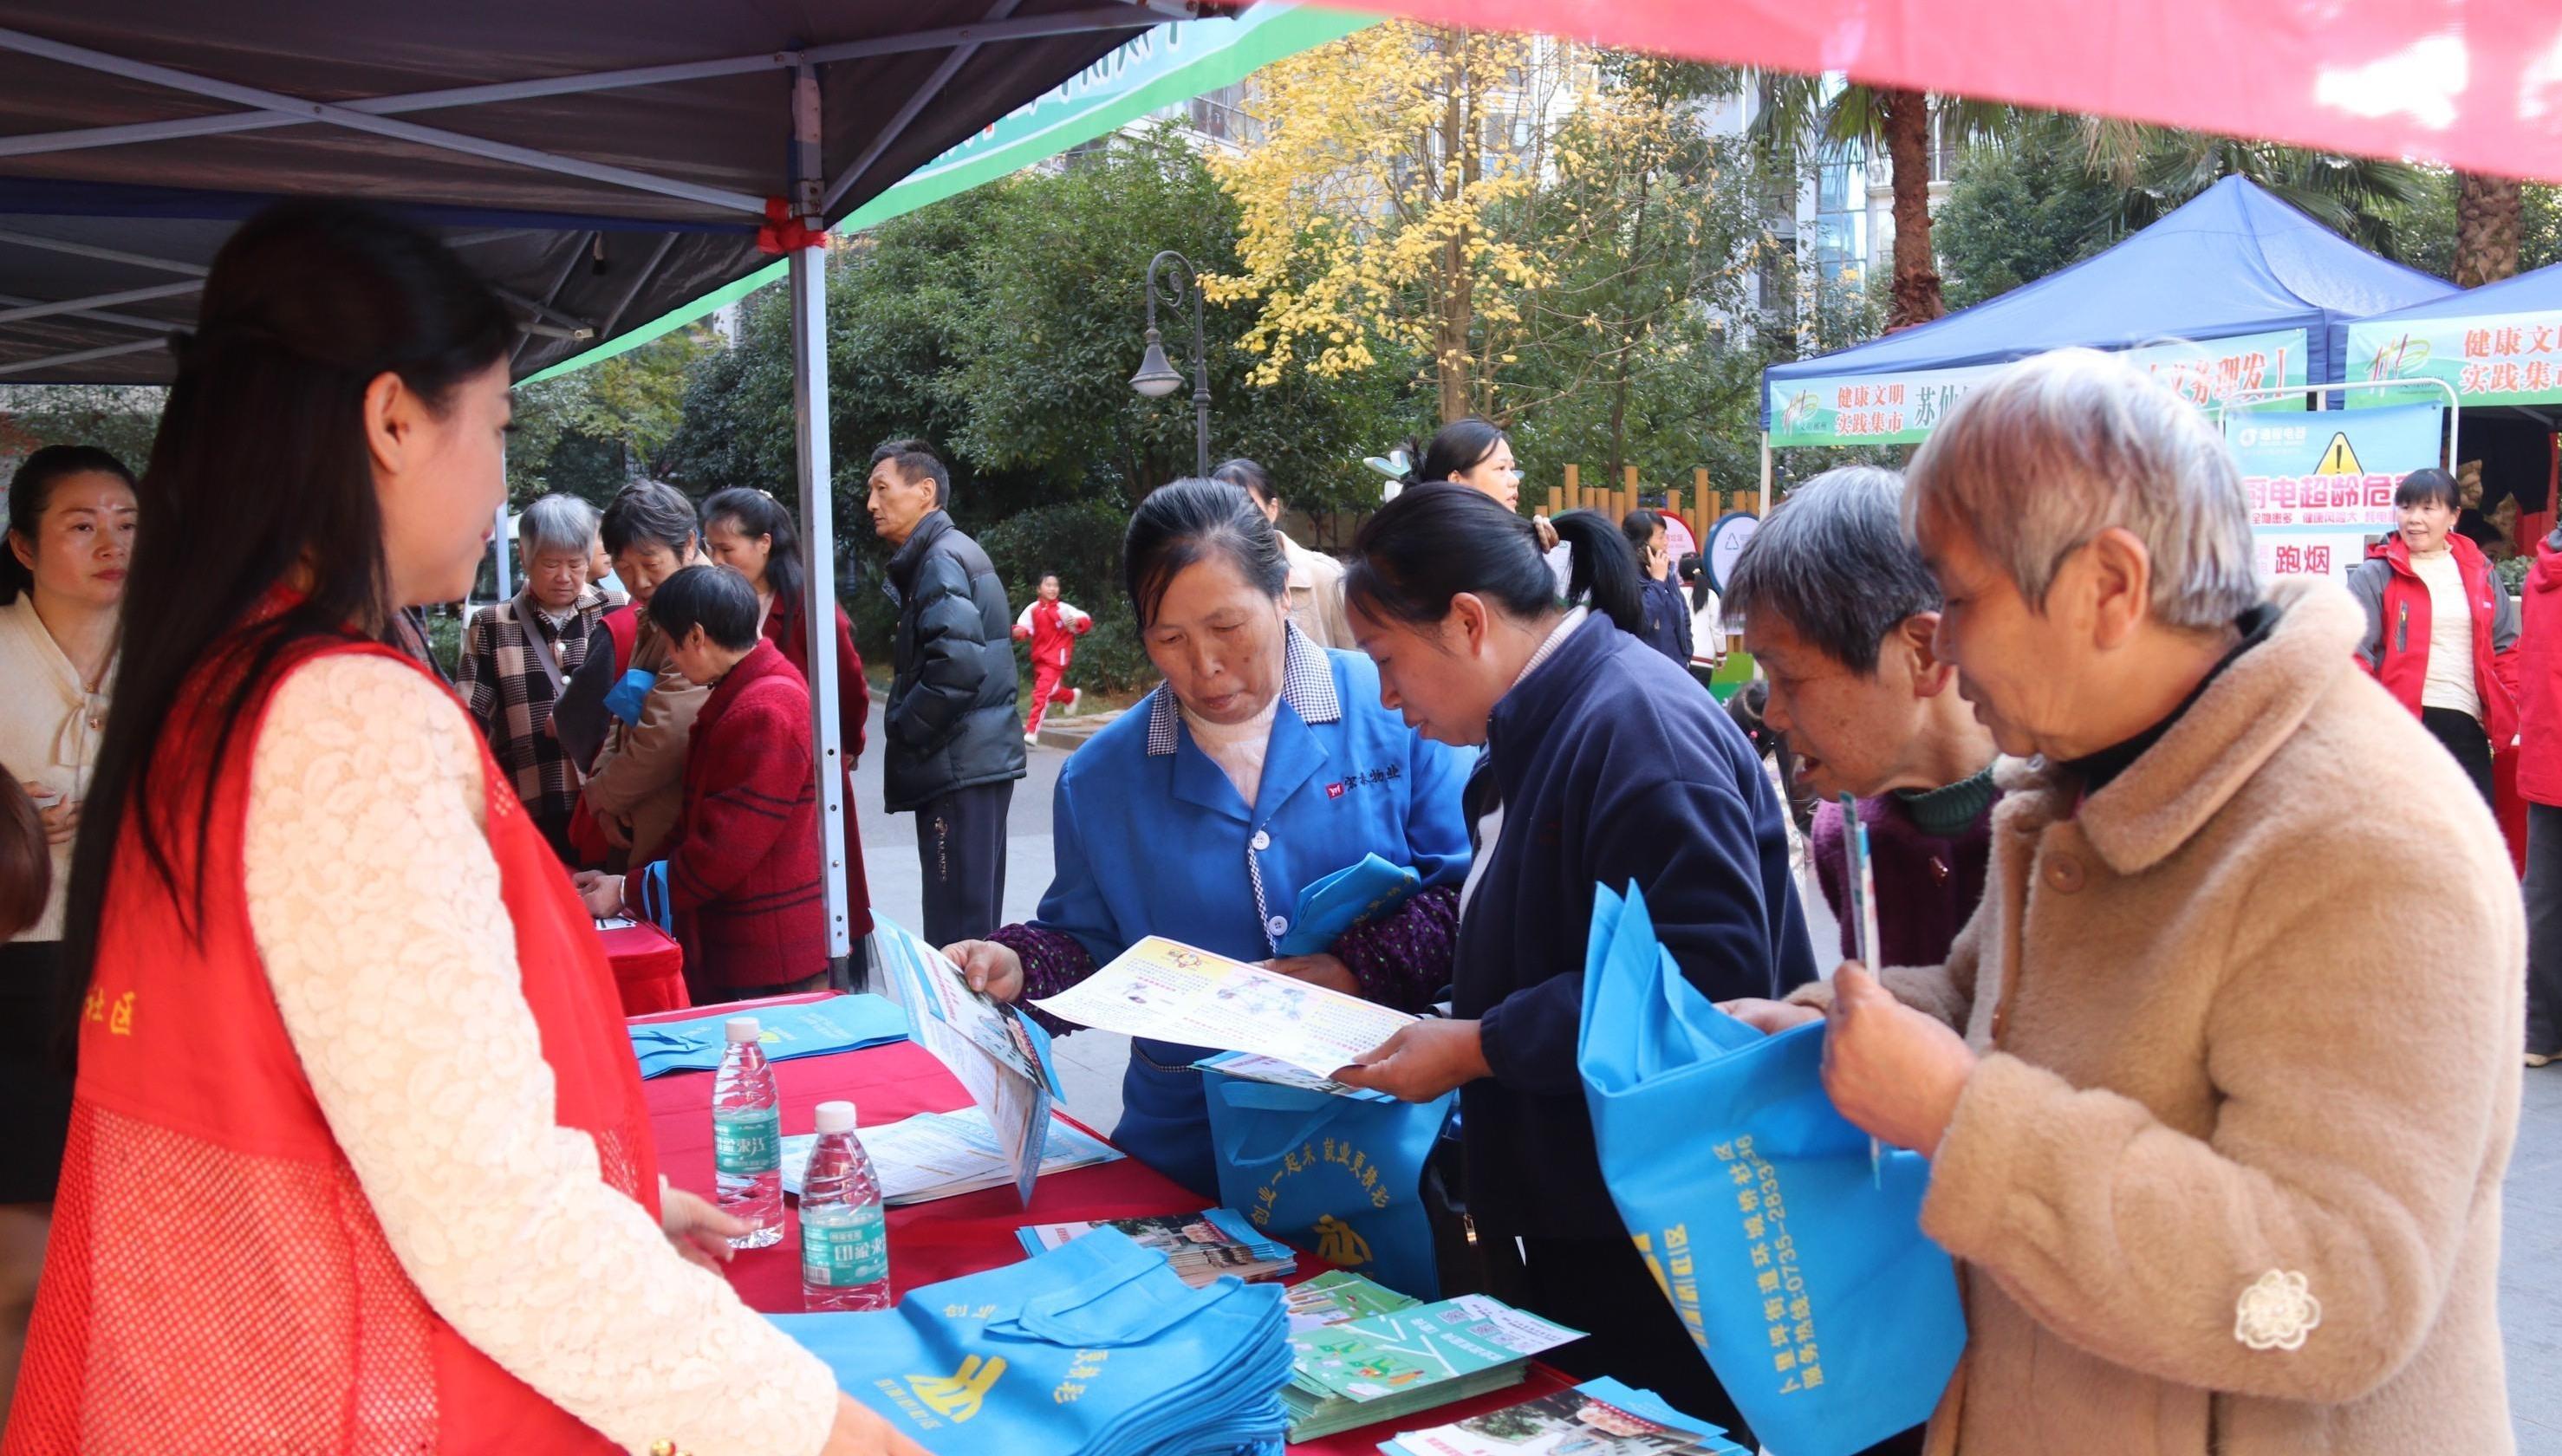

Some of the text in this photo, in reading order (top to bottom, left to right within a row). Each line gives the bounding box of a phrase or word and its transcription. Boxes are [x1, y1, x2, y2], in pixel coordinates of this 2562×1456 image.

[2463, 324, 2562, 359] 健康文
[1837, 384, 1905, 408] 健康文明
[1915, 384, 1970, 426] 苏仙
[1836, 411, 1903, 435] 实践集市
[2247, 474, 2405, 510] 厨电超龄危
[2275, 545, 2330, 575] 跑烟
[1251, 1136, 1390, 1226] 创业一起来 就业更精彩
